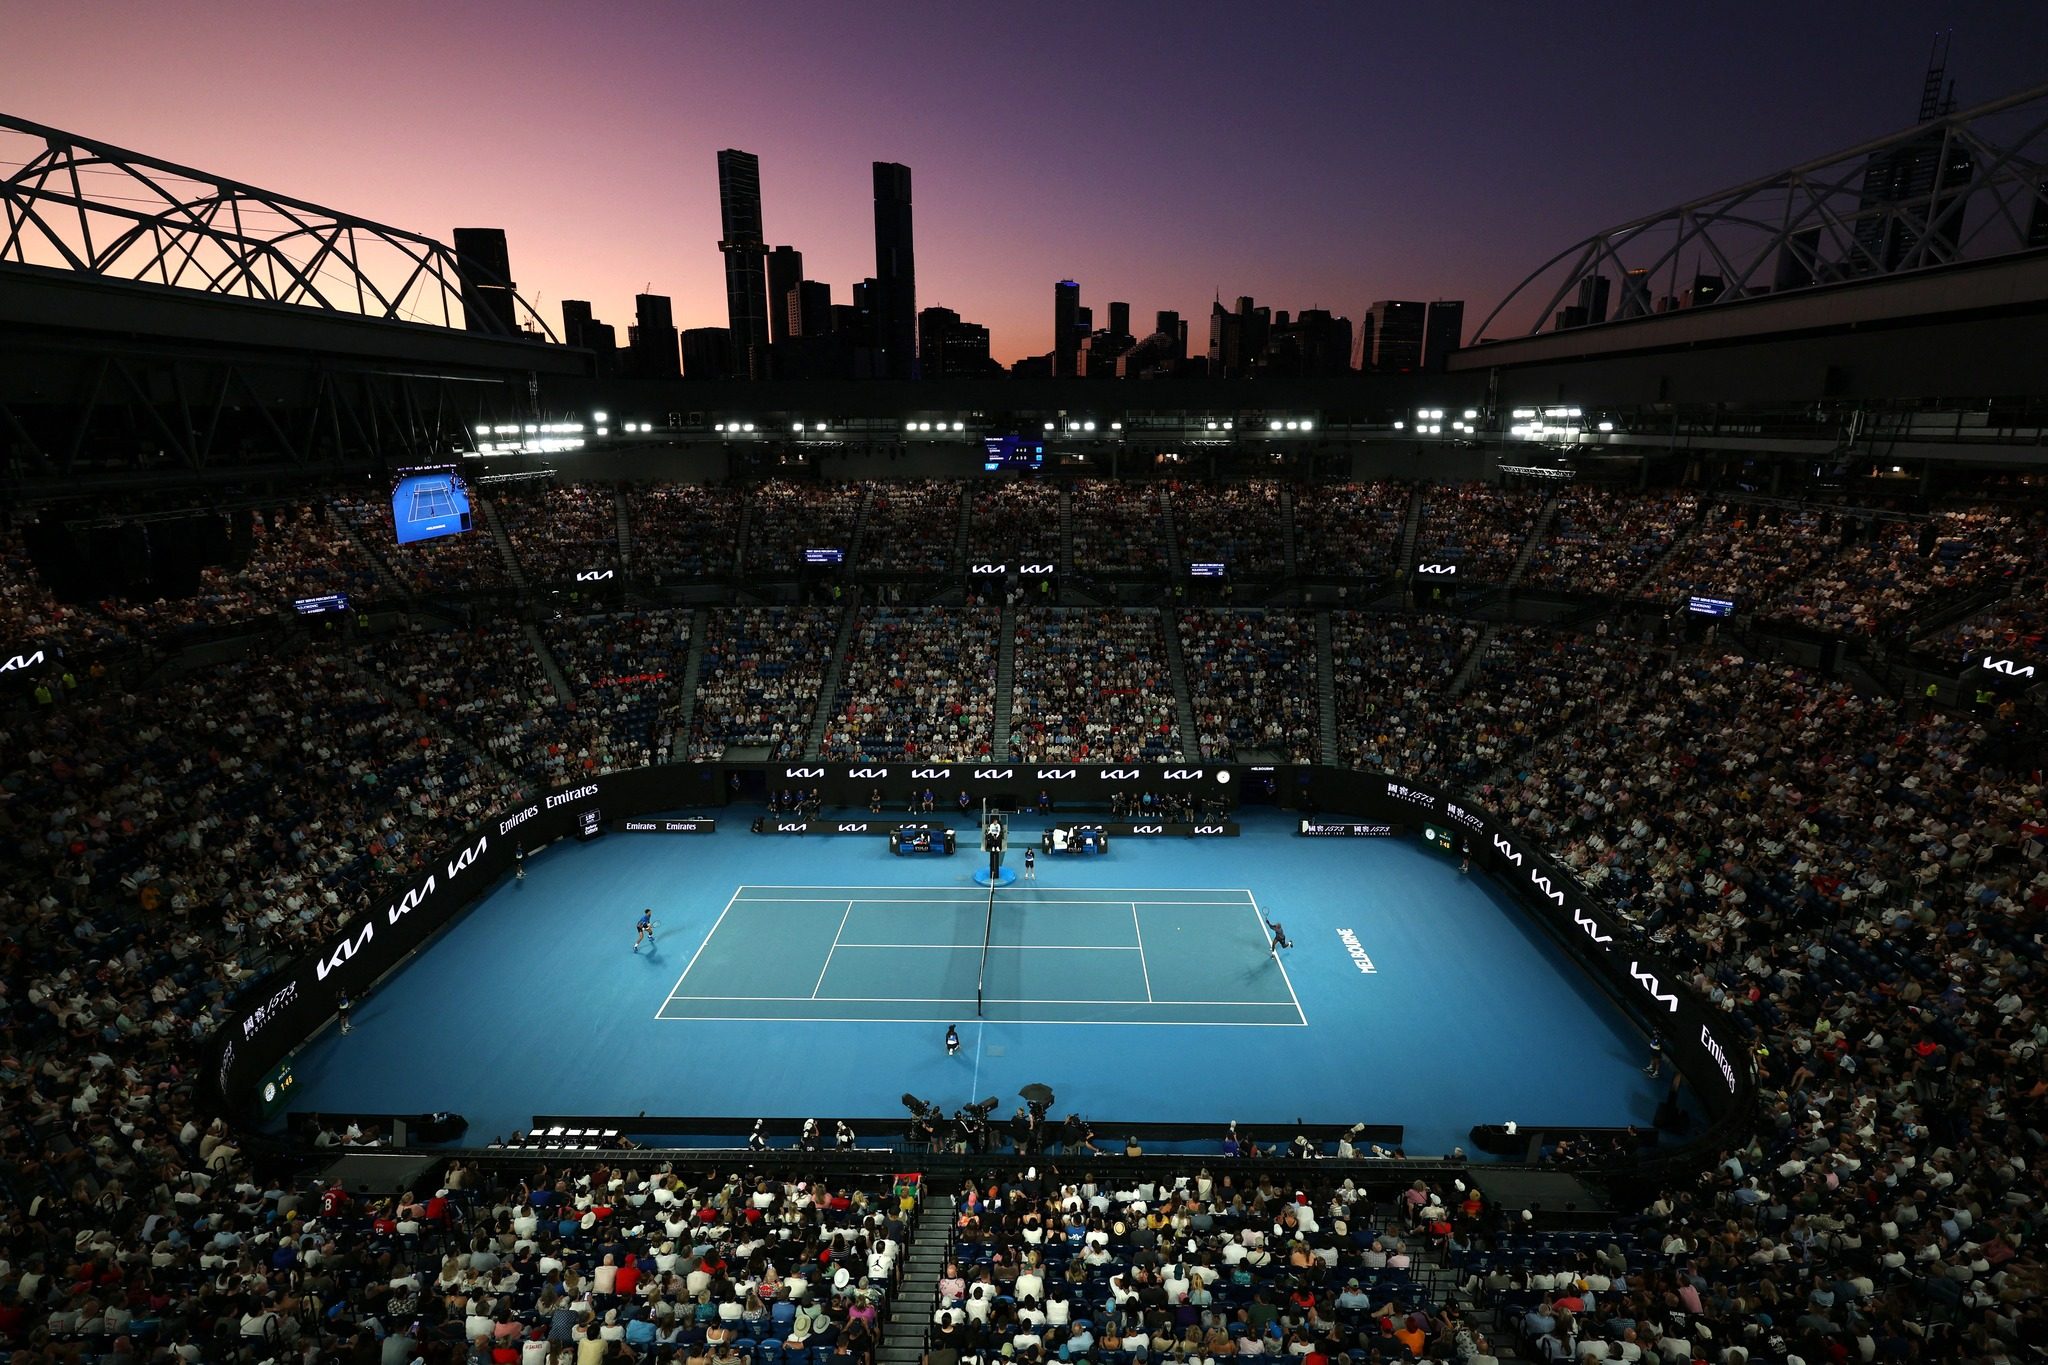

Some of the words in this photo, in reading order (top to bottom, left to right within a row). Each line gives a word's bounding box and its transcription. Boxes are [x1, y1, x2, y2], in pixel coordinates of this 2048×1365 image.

[973, 565, 1005, 574] KIA
[1021, 565, 1053, 574] KIA
[1419, 564, 1455, 574] KIA
[577, 570, 613, 581] KIA
[1983, 656, 2034, 677] KIA
[787, 768, 824, 778] KIA
[849, 769, 887, 778] KIA
[912, 769, 949, 778] KIA
[974, 769, 1012, 778] KIA
[1038, 770, 1076, 779] KIA
[1101, 770, 1139, 779] KIA
[1164, 770, 1202, 779] KIA
[546, 783, 598, 809] Emirates
[499, 804, 539, 836] Emirates
[626, 822, 657, 830] Emirates
[666, 823, 697, 831] Emirates
[778, 823, 806, 832] KIA
[839, 823, 867, 832] KIA
[1134, 825, 1163, 834] KIA
[1195, 825, 1224, 834] KIA
[1493, 834, 1522, 866] KIA
[448, 836, 487, 879] KIA
[1532, 869, 1564, 906] KIA
[389, 875, 436, 924] KIA
[317, 921, 373, 980] KIA
[1335, 928, 1378, 974] MELBOURNE
[1631, 962, 1678, 1012] KIA
[1701, 1024, 1736, 1094] Emirates
[325, 1199, 331, 1211] 8
